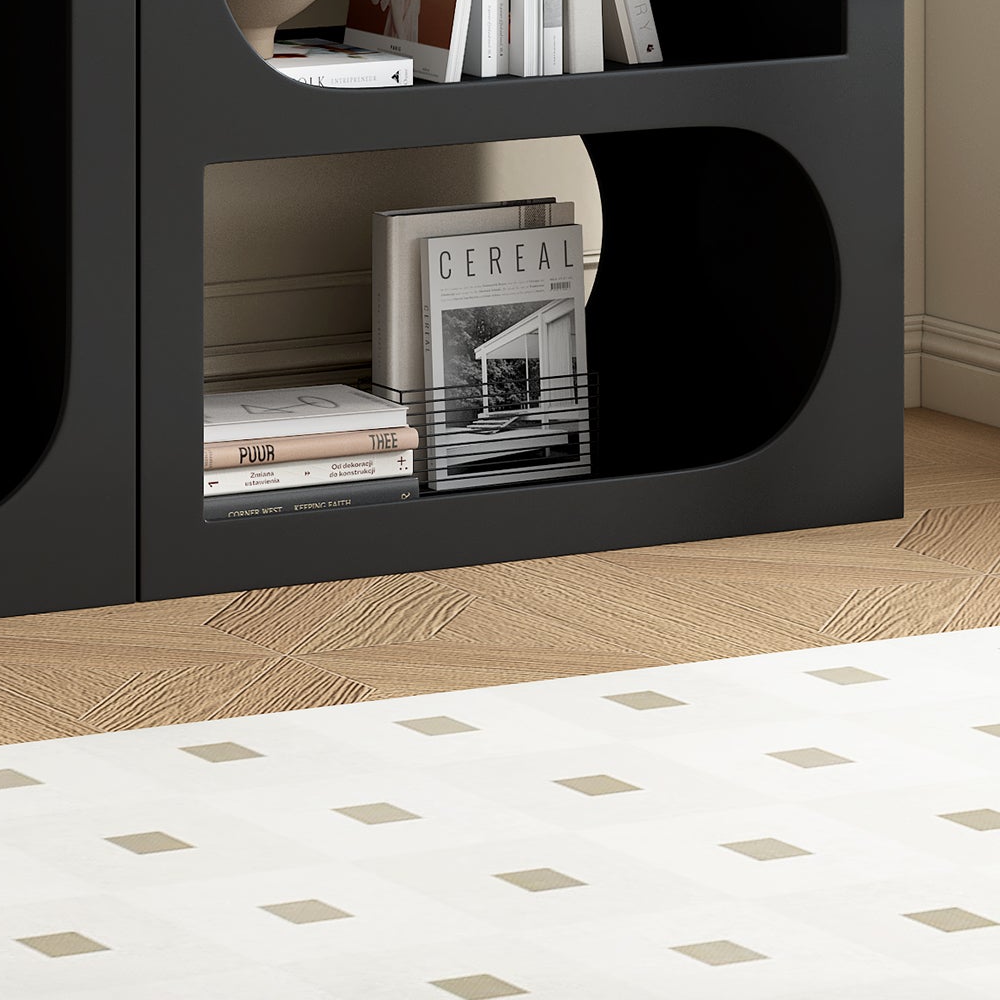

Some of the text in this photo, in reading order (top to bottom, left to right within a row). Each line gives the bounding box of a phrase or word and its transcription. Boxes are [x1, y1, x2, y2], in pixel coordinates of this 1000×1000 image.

[439, 239, 574, 280] CEREAL
[239, 432, 398, 464] PUUR THEE
[342, 460, 373, 470] dekoracji
[250, 471, 275, 479] Zmiana
[339, 468, 376, 477] konstrukcji
[244, 478, 280, 487] ustawienia
